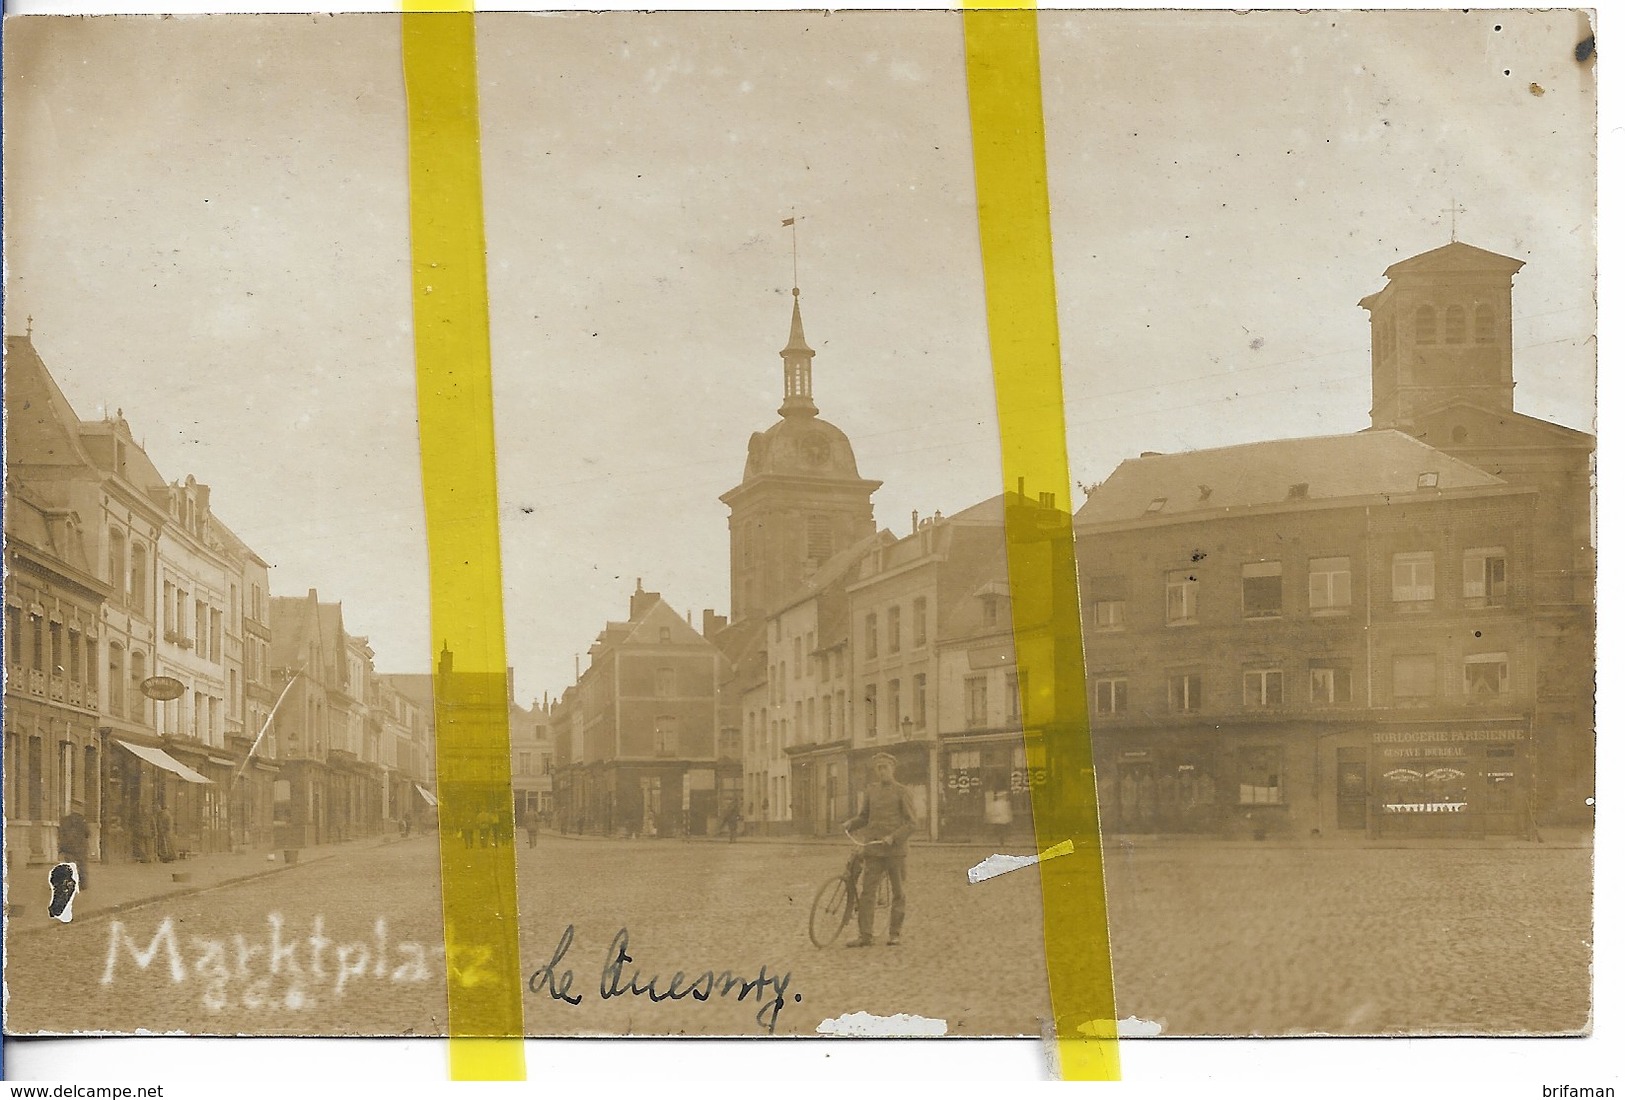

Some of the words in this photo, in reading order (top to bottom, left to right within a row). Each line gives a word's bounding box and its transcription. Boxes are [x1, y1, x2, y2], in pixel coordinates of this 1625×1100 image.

[1373, 732, 1448, 742] HORLOGERIE
[1451, 730, 1524, 741] PARISIENNE
[100, 911, 500, 995] Marktplatz
[529, 924, 582, 1005] Le
